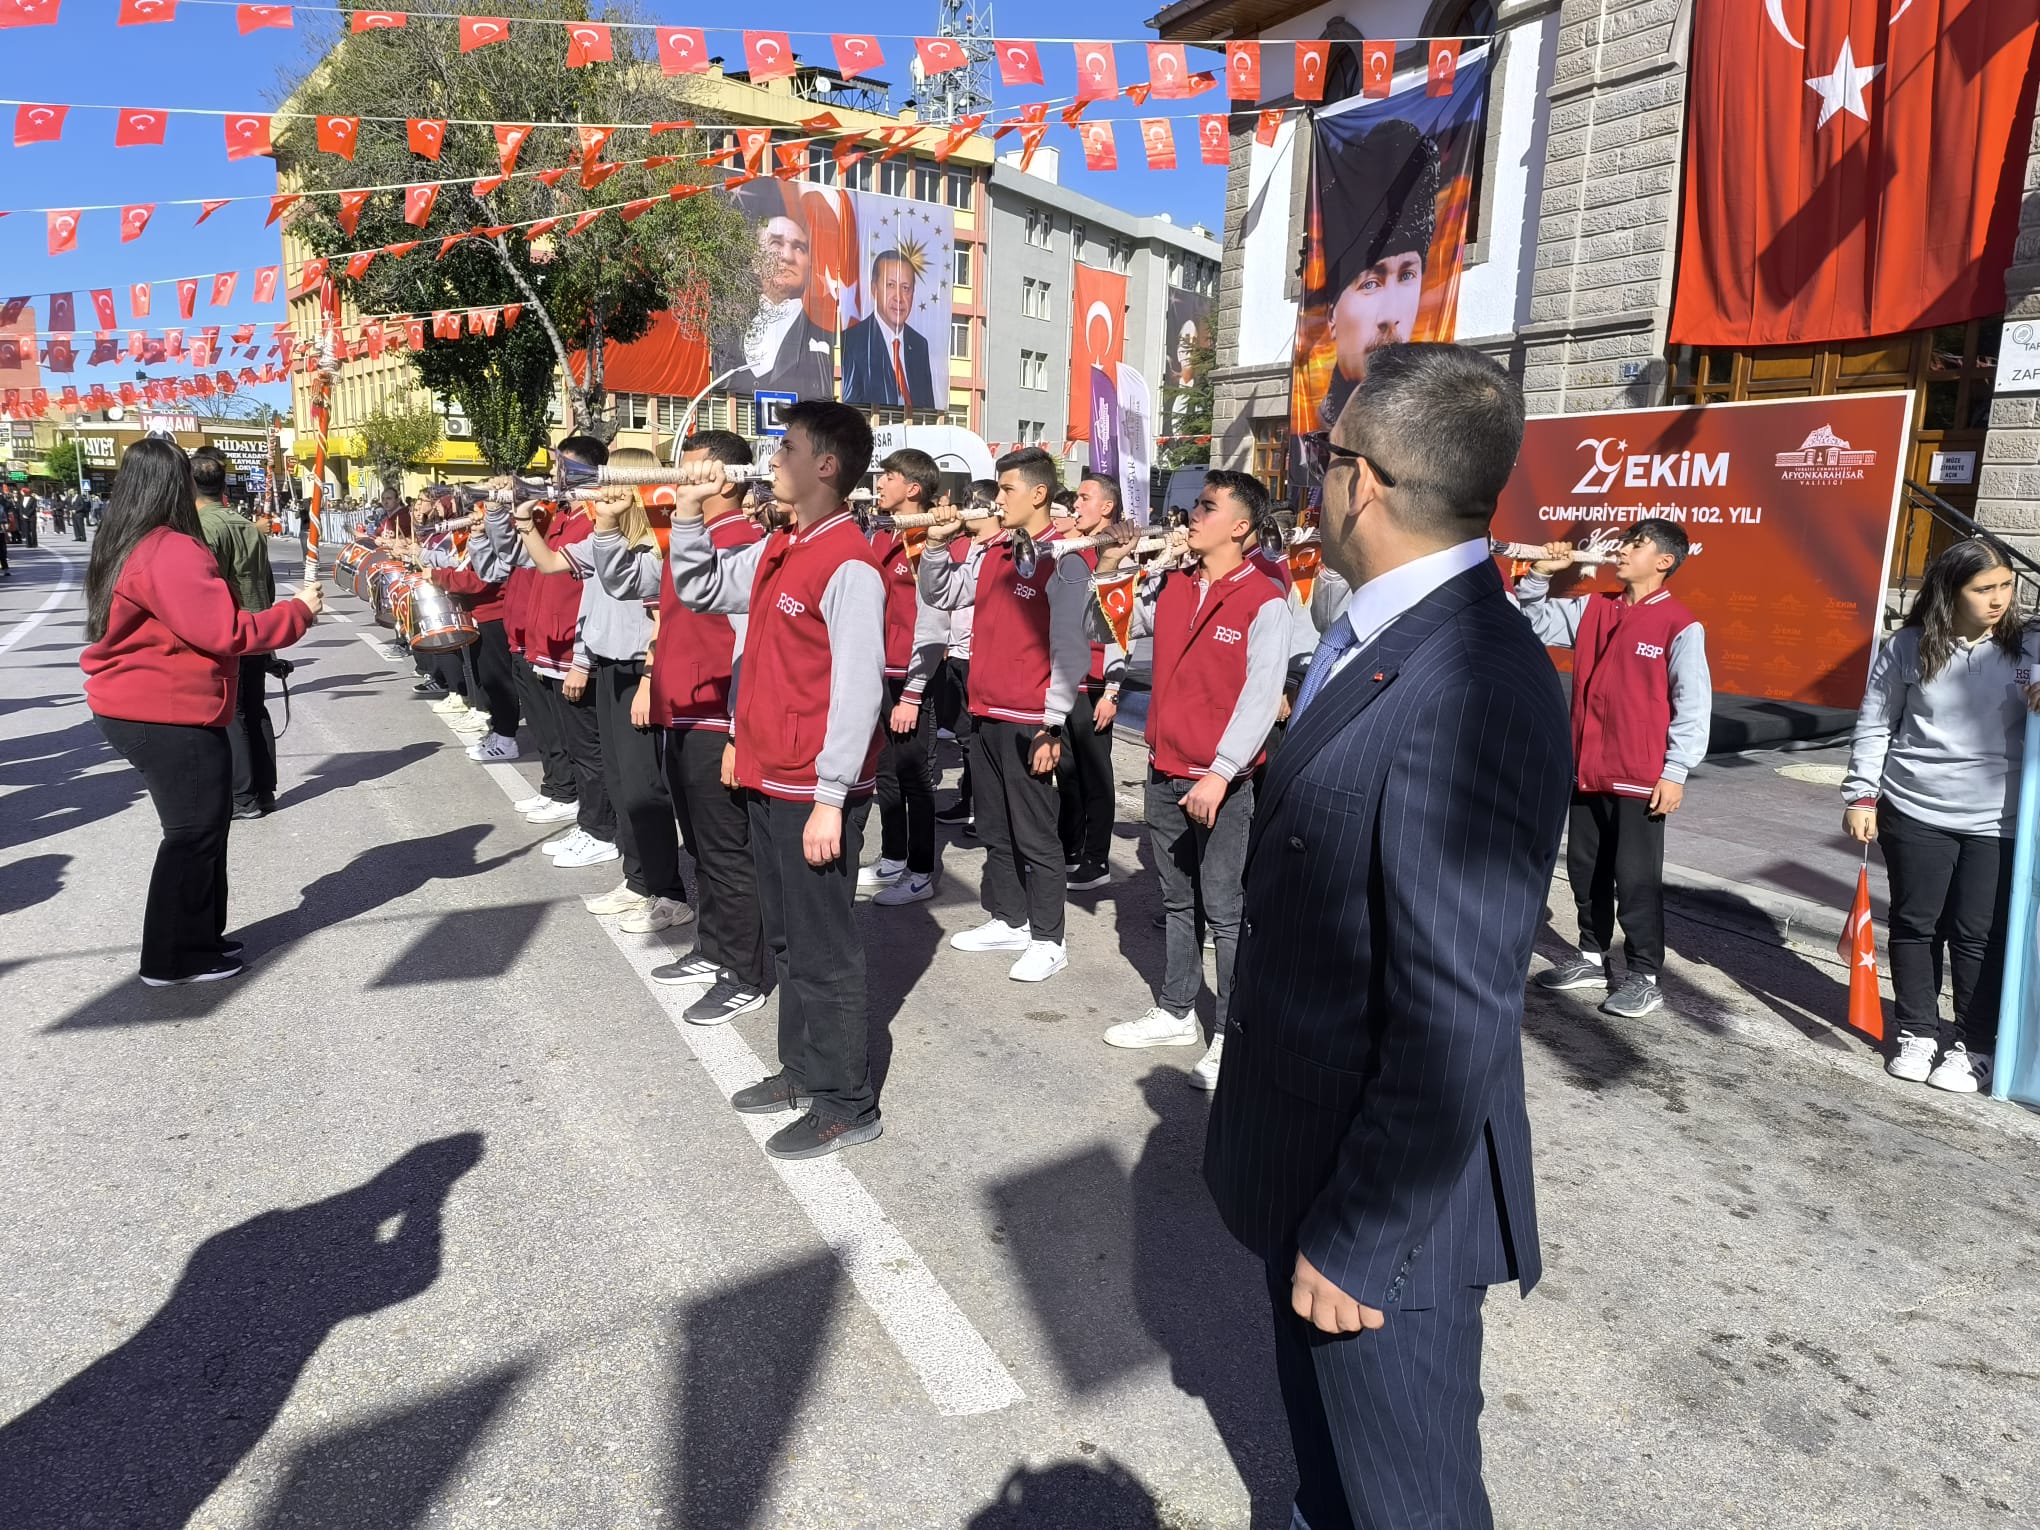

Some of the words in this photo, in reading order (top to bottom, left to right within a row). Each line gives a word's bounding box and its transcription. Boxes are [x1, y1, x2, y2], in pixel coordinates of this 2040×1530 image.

[1571, 437, 1628, 493] 29
[1781, 469, 1864, 480] AFYONKARAHİSAR
[1538, 502, 1687, 523] CUMHURİYETİMİZİN
[1691, 507, 1724, 523] 102.
[1729, 507, 1762, 524] YILI
[1013, 583, 1037, 599] RSP
[776, 592, 805, 616] RSP
[1213, 625, 1242, 645] RSP
[1635, 641, 1664, 659] RSP
